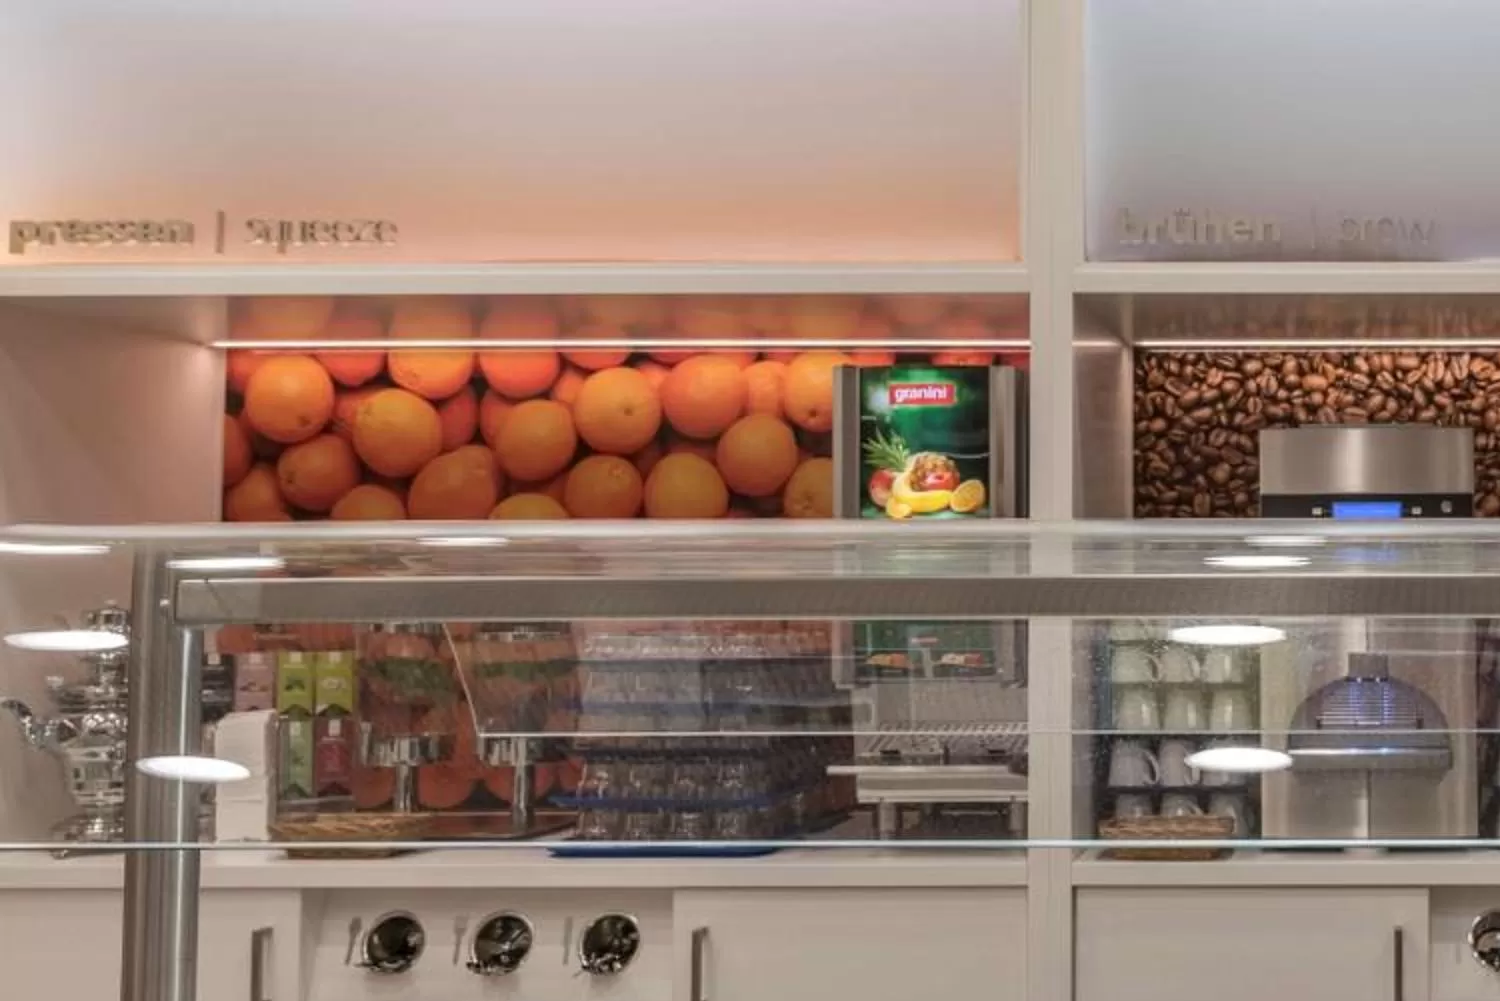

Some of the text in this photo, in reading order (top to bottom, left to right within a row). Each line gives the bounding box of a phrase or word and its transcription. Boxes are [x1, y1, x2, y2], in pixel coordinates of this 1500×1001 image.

[8, 216, 400, 255] pressen squeeze
[895, 385, 947, 403] granini
